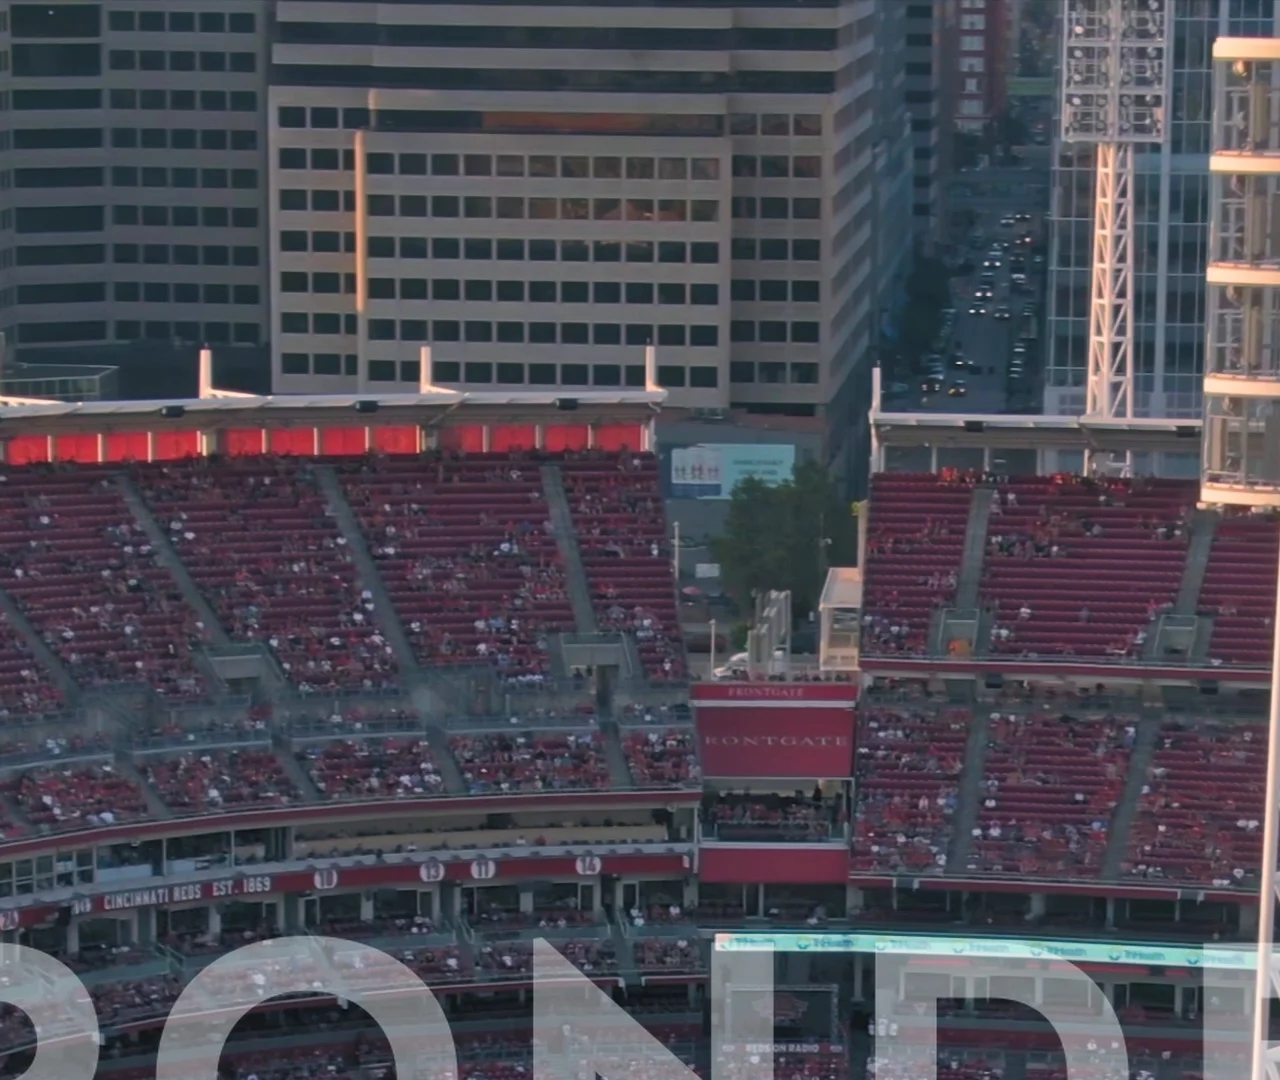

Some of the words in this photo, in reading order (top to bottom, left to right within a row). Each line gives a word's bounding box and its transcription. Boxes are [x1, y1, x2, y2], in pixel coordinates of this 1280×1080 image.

[104, 887, 169, 911] CINCINNATI
[173, 883, 202, 901] REDS
[212, 880, 239, 897] EST.
[243, 876, 272, 893] 1869
